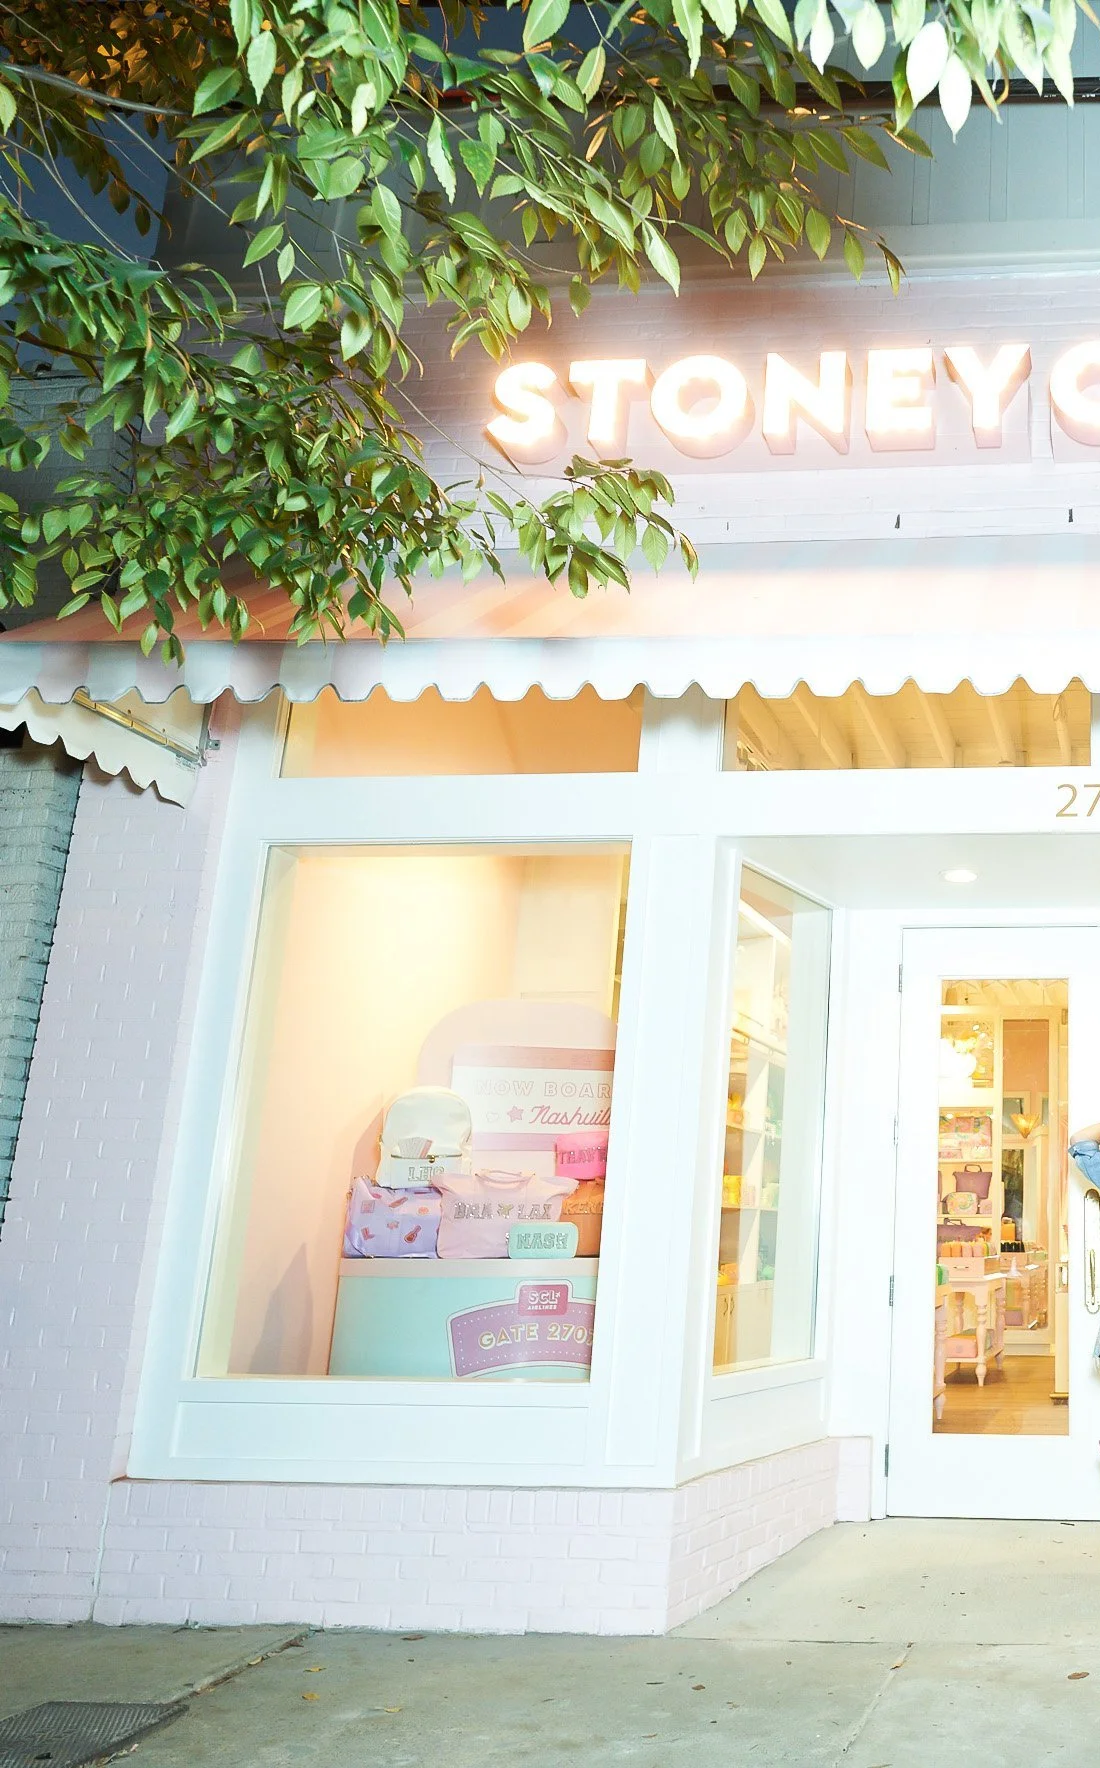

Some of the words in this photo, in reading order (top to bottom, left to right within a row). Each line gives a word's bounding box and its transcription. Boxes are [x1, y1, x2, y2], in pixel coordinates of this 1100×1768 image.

[487, 342, 1033, 462] STONEY
[477, 1080, 534, 1097] NOW
[517, 1203, 553, 1219] LAX
[516, 1232, 569, 1251] NASH
[527, 1290, 558, 1305] SCL
[478, 1322, 540, 1350] GATE
